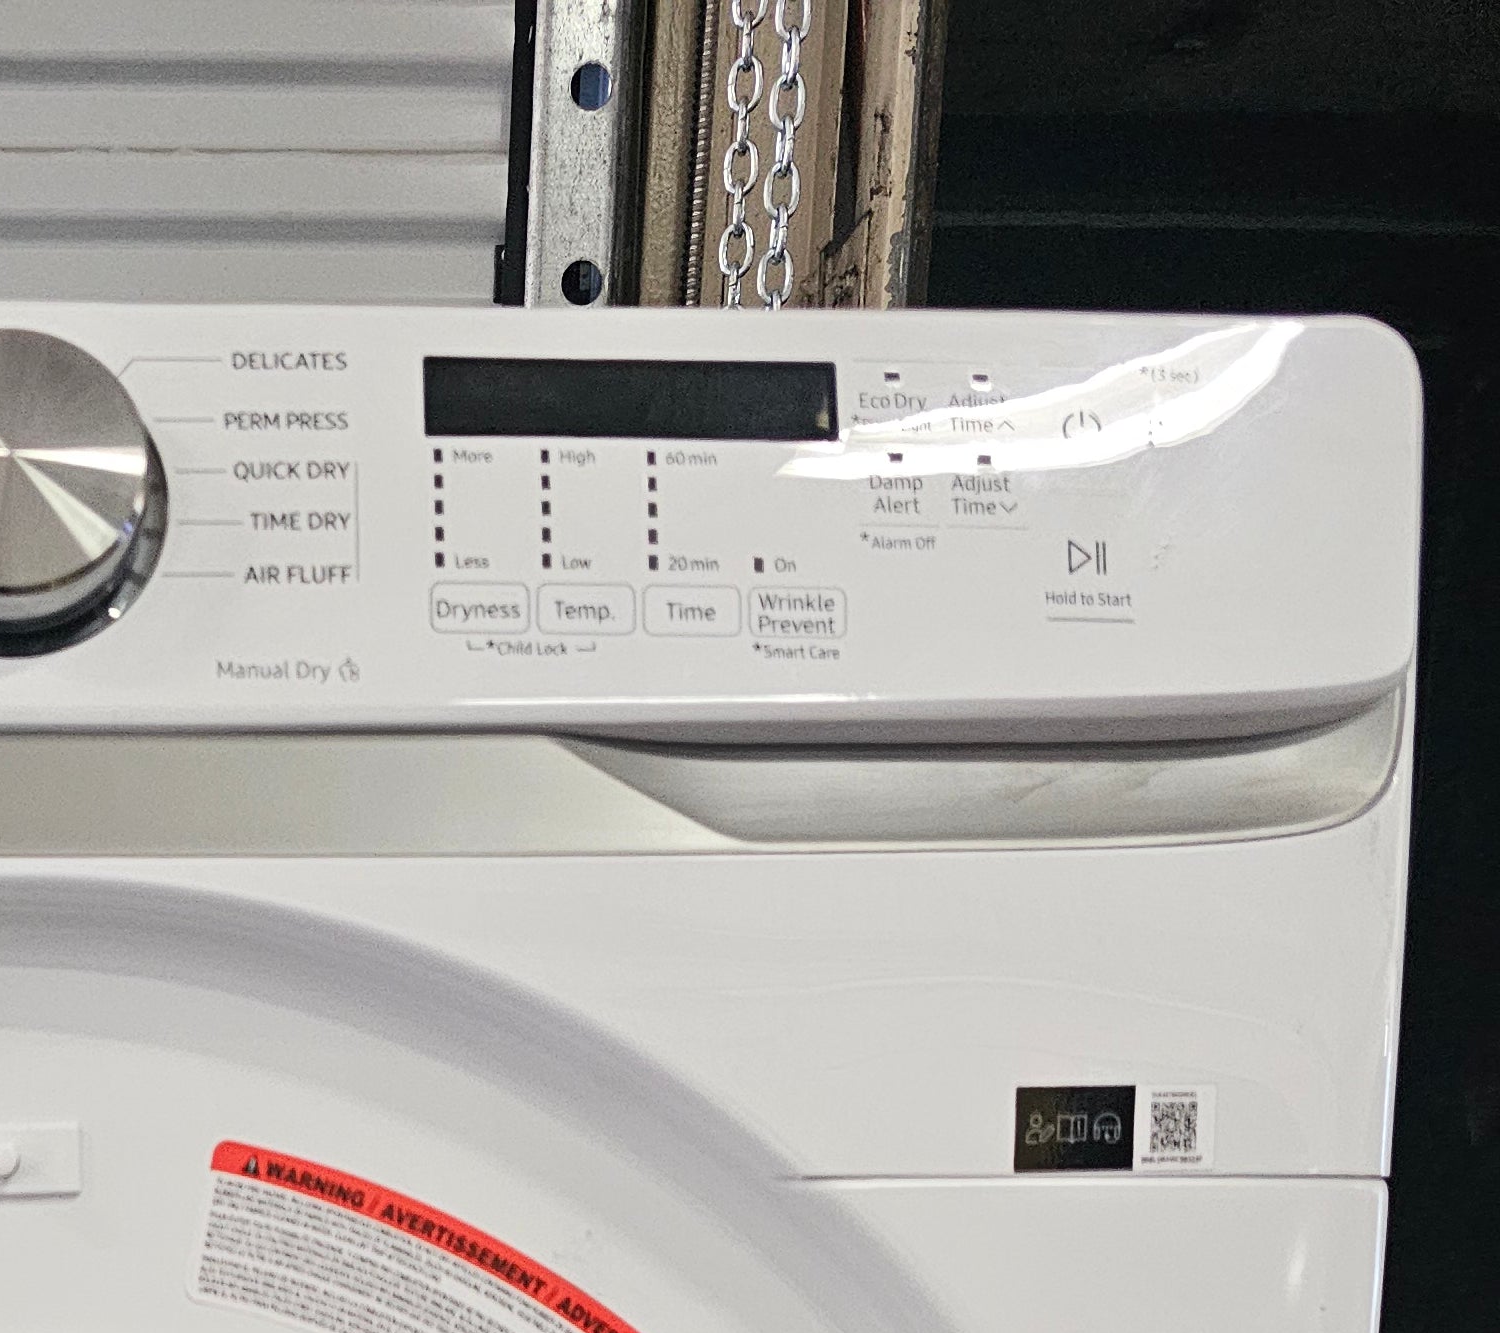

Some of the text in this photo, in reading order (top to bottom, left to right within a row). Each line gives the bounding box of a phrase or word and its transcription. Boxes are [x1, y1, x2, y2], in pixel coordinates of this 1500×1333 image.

[232, 351, 348, 371] DELICATES
[859, 392, 927, 411] Eco Dry
[224, 412, 349, 431] PERM PRESS
[950, 416, 994, 433] Time
[452, 449, 493, 464] More
[559, 449, 596, 468] High
[233, 460, 350, 483] QUICK DRY
[869, 475, 923, 493] Damp
[952, 475, 1011, 494] Adjust
[874, 495, 920, 514] Alert
[951, 497, 997, 516] Time
[250, 511, 351, 531] TIME DRY
[915, 537, 936, 550] Off
[455, 555, 490, 570] Less
[562, 555, 592, 570] Low
[773, 557, 797, 573] On
[244, 565, 351, 584] AIR FLUFF
[759, 592, 835, 613] Wrinkle
[1044, 591, 1131, 607] Hold to Start
[437, 600, 521, 621] Dryness
[555, 600, 616, 622] Temp.
[667, 602, 716, 621] Time
[758, 615, 835, 636] Prevent
[537, 641, 567, 656] Lock
[810, 644, 840, 658] Care
[216, 660, 331, 684] Manual Dry
[267, 1161, 366, 1209] WARNING
[381, 1204, 548, 1296] AVERTISSEMENT
